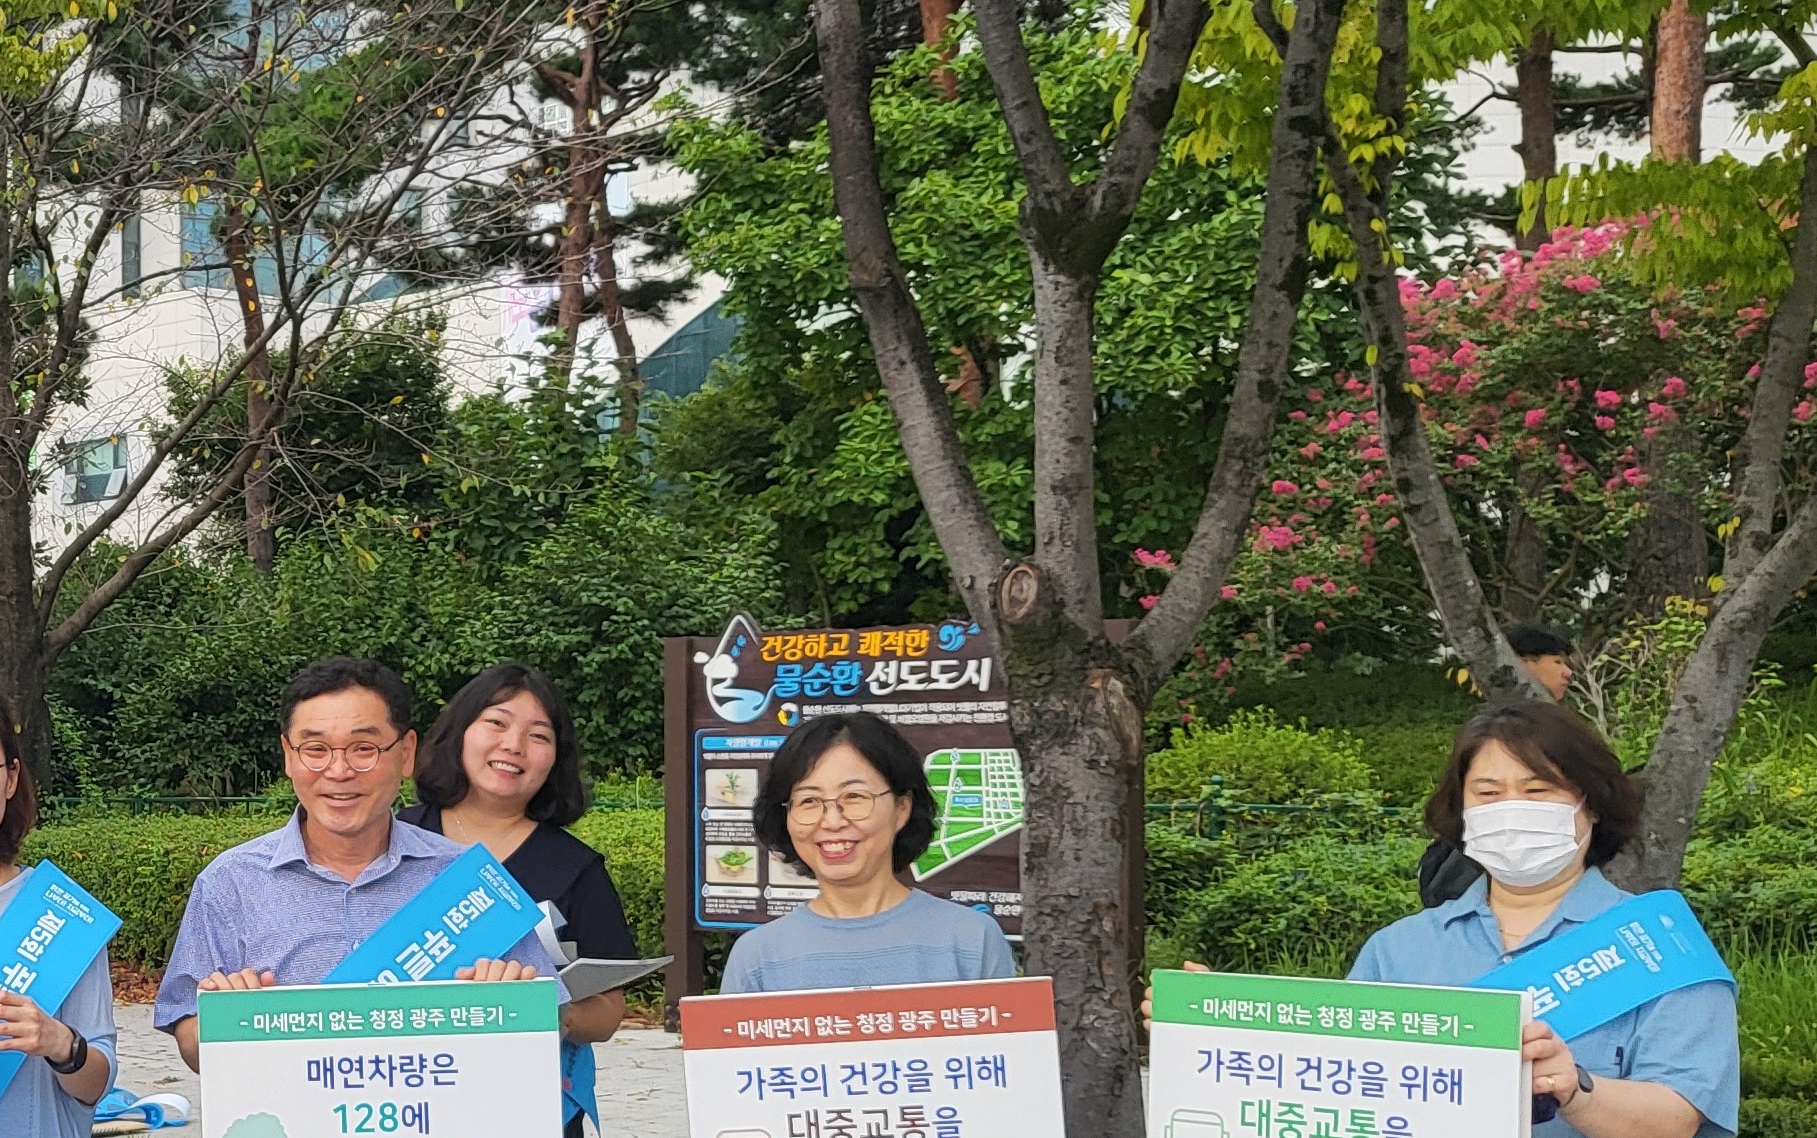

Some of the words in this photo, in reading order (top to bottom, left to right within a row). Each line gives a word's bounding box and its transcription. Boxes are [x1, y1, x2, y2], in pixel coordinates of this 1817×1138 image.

[761, 633, 849, 662] 건강하고
[857, 629, 930, 657] 쾌적한
[772, 660, 863, 697] 물순환
[864, 657, 992, 696] 선도도시
[441, 885, 495, 935] 제5회
[16, 908, 66, 963] 제5회
[1552, 944, 1626, 993] 제5회
[253, 1011, 323, 1034] 미세먼지
[328, 1010, 365, 1031] 없는
[369, 1008, 404, 1030] 청정
[409, 1007, 446, 1029] 광주
[450, 1005, 503, 1027] 만들기
[736, 1016, 811, 1041] 미세먼지
[814, 1015, 853, 1037] 없는
[855, 1011, 895, 1035] 청정
[897, 1010, 938, 1033] 광주
[940, 1005, 999, 1030] 만들기
[1203, 997, 1272, 1023] 미세먼지
[1276, 1003, 1313, 1026] 없는
[1317, 1005, 1353, 1030] 청정
[1358, 1009, 1397, 1032] 광주
[1401, 1012, 1459, 1038] 만들기
[306, 1053, 459, 1090] 매연차량은
[736, 1063, 829, 1101] 가족의
[839, 1058, 934, 1096] 건강을
[944, 1053, 1007, 1090] 위해
[1197, 1047, 1283, 1089] 가족의
[1295, 1056, 1389, 1099] 건강을
[1399, 1065, 1463, 1106] 위해
[332, 1101, 430, 1135] 128에
